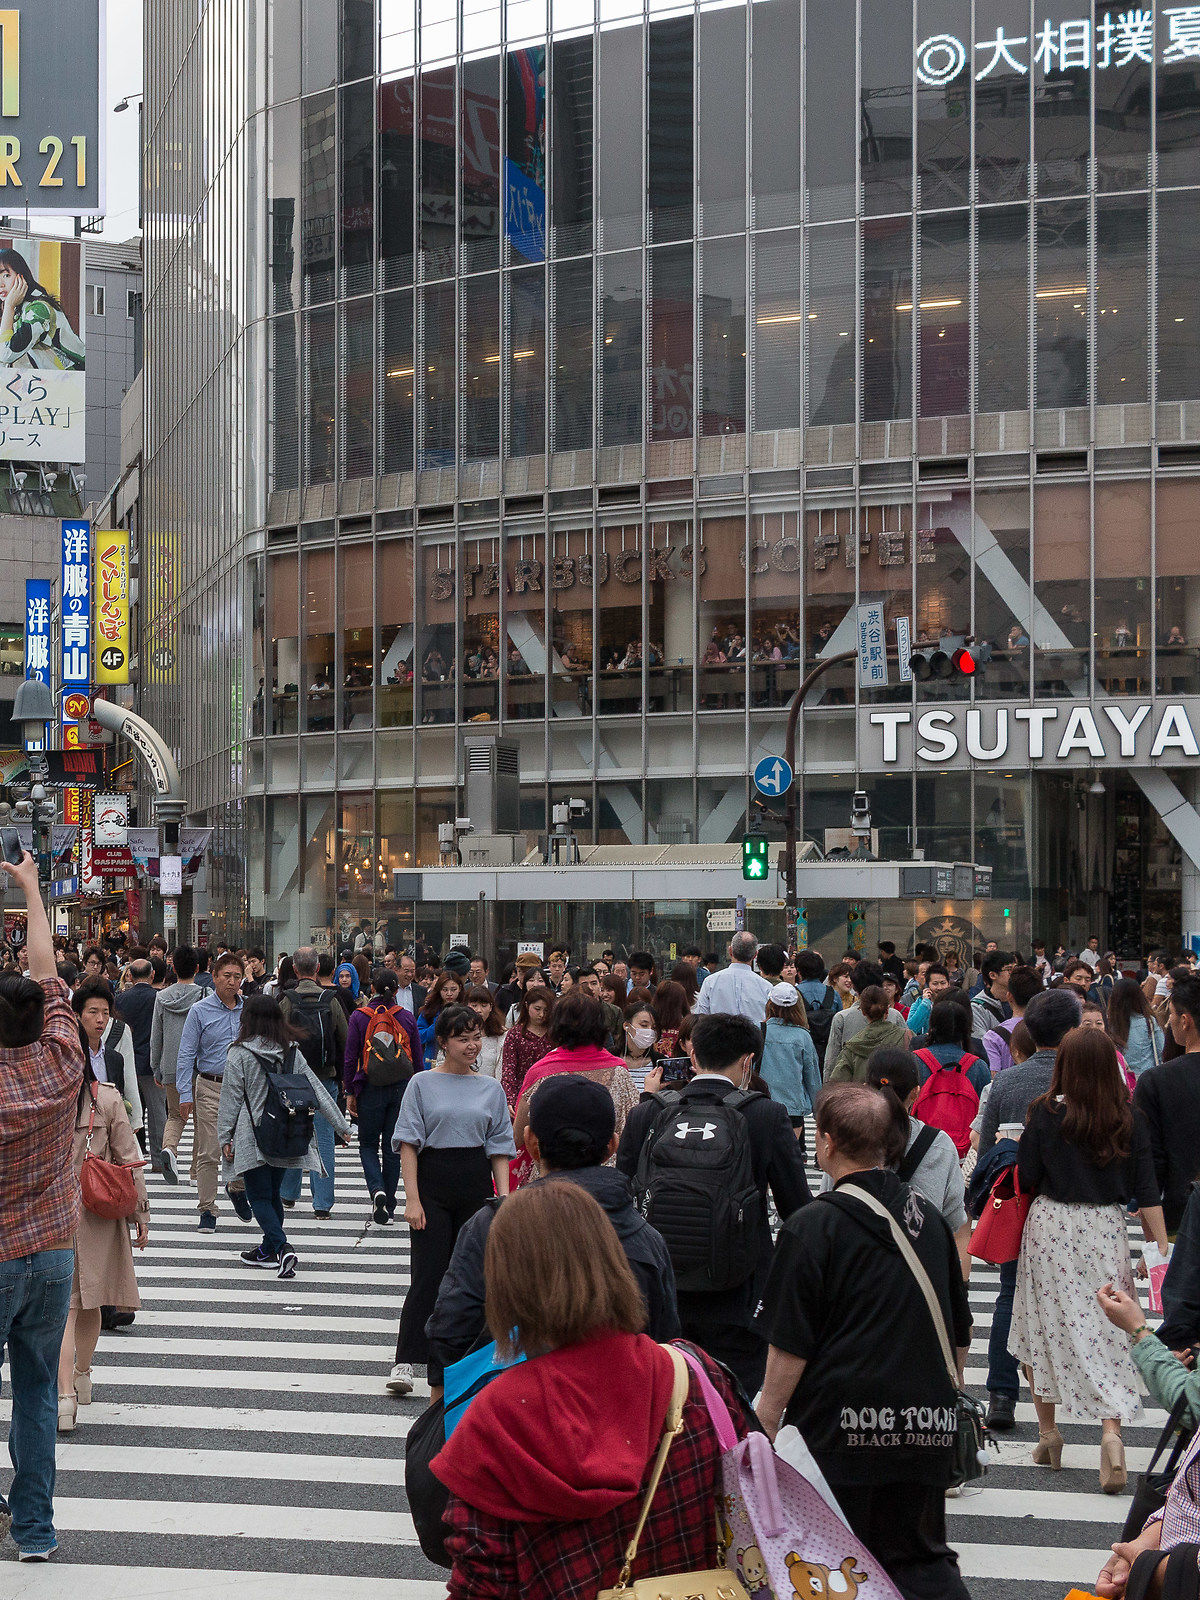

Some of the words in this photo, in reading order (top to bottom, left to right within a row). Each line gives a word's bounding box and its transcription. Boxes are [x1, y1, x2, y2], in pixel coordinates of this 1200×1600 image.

[39, 134, 87, 187] 21
[99, 544, 126, 641] くいしんぼ
[430, 543, 707, 601] STARBUCKS
[739, 529, 936, 574] COFFEE
[62, 528, 89, 680] 洋服の青山
[102, 651, 122, 665] 4F
[868, 610, 883, 680] 渋谷駅前
[900, 621, 909, 678] スクランブル式
[871, 705, 1200, 762] TSUTAYA
[840, 1406, 896, 1431] DOG
[847, 1433, 901, 1447] BLACK
[904, 1433, 954, 1447] DRAGO
